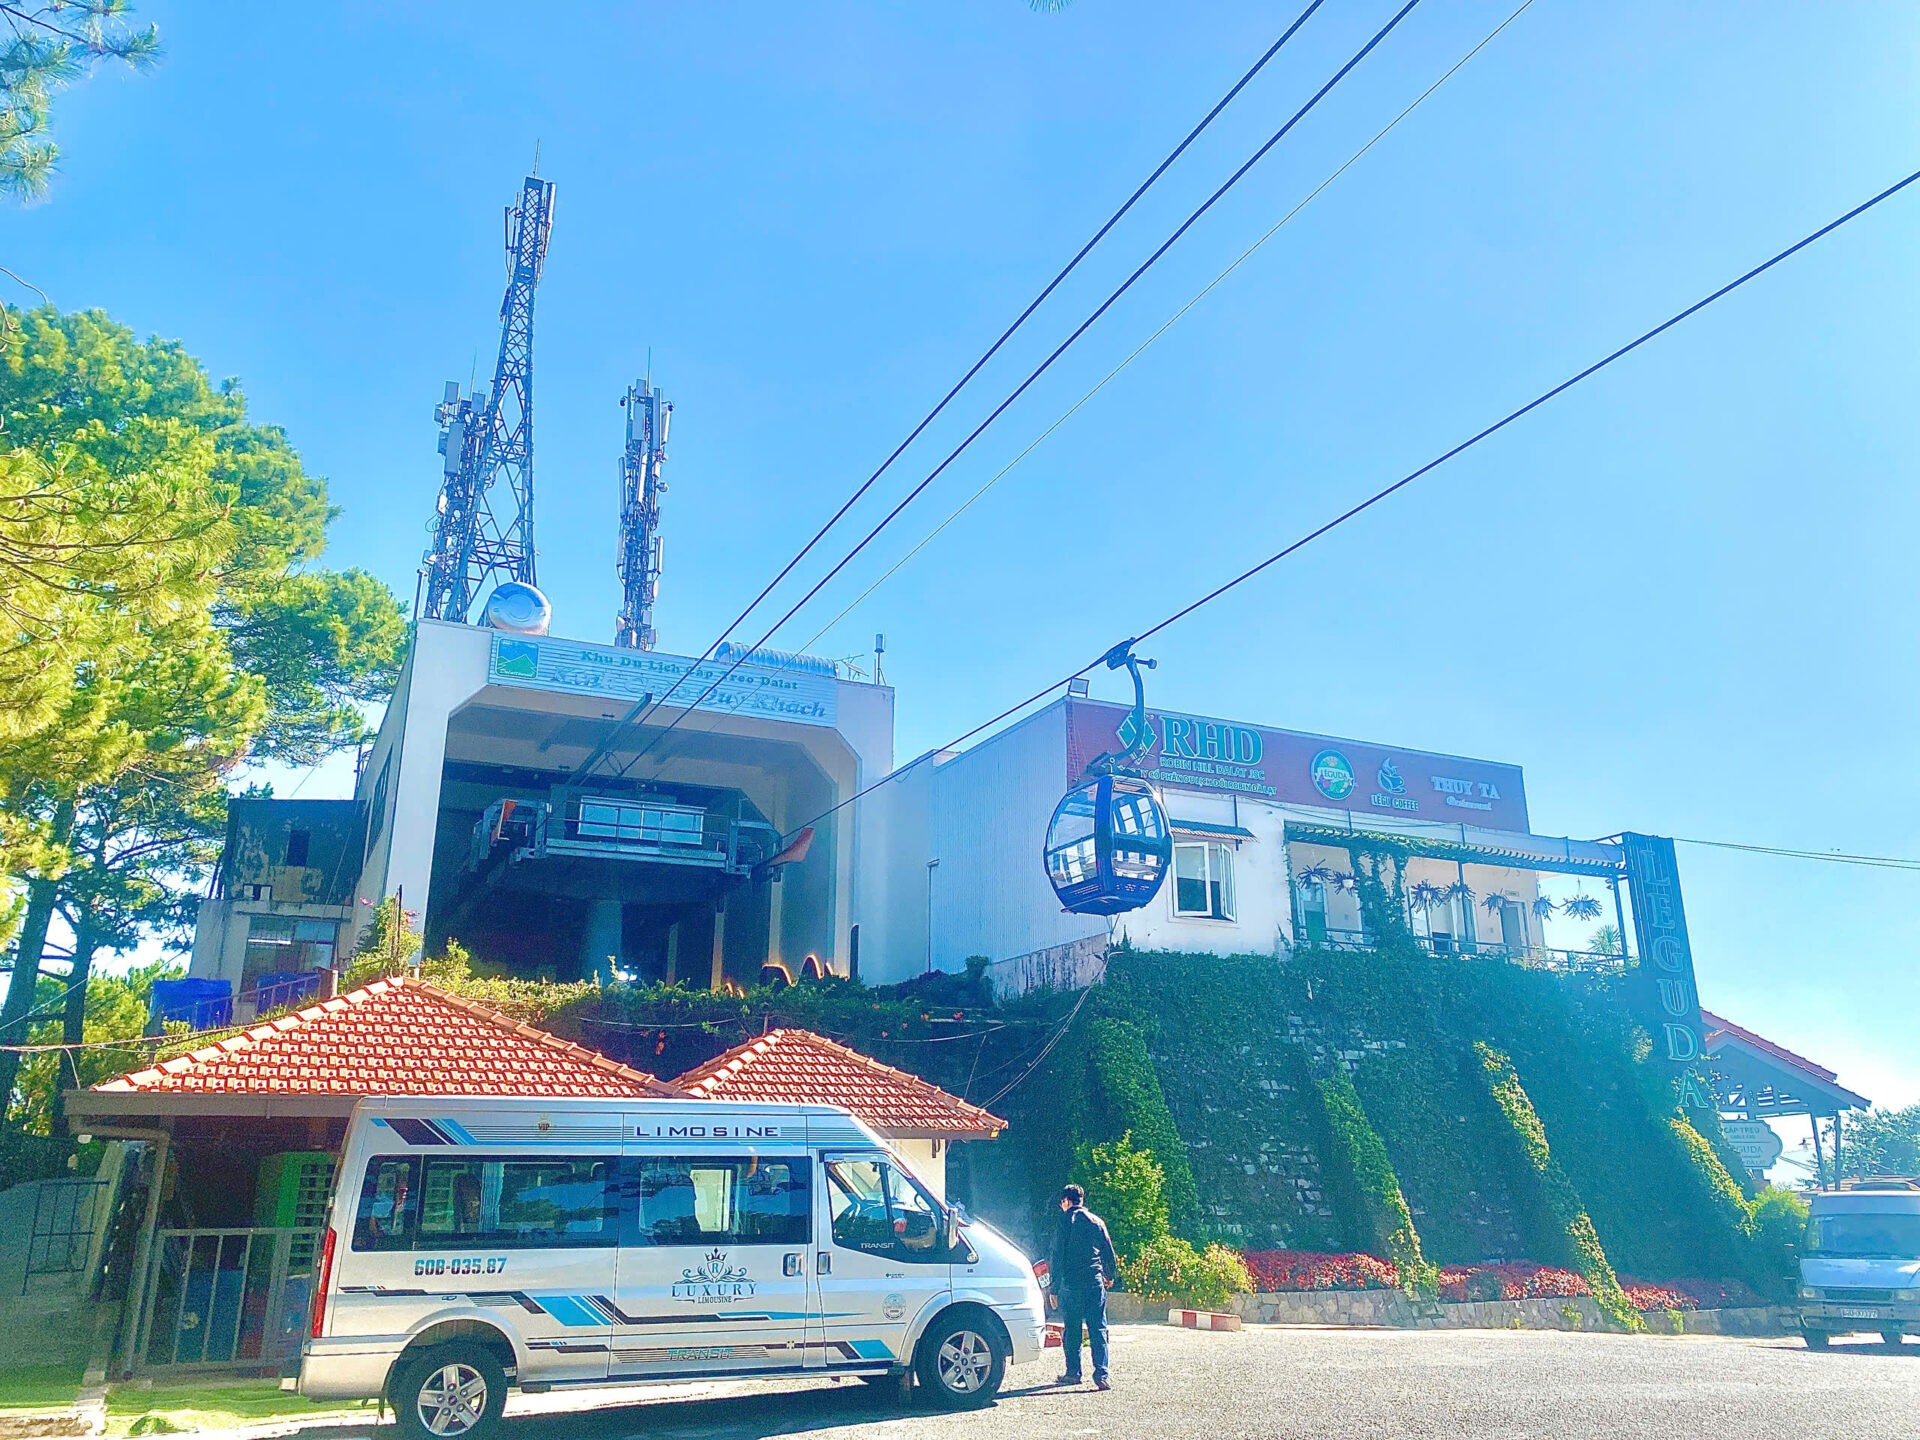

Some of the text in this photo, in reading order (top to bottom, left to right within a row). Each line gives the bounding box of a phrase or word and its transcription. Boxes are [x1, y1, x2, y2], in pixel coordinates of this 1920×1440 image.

[581, 650, 613, 663] Khu
[761, 676, 799, 690] Dalat
[1159, 714, 1264, 767] RHD
[1160, 756, 1266, 781] ROBIN HILL DALAT JSC
[1184, 775, 1196, 785] DU
[1228, 780, 1251, 792] ROBIN
[1370, 793, 1419, 811] LÉGU COFFEE
[538, 1122, 550, 1131] VIP
[636, 1126, 778, 1137] LIMOSINE
[414, 1256, 508, 1276] 60B-035.87
[711, 1262, 719, 1274] R
[671, 1283, 757, 1297] LUXURY
[697, 1295, 732, 1304] LIMOUSINE
[667, 1348, 736, 1361] TRANSIT
